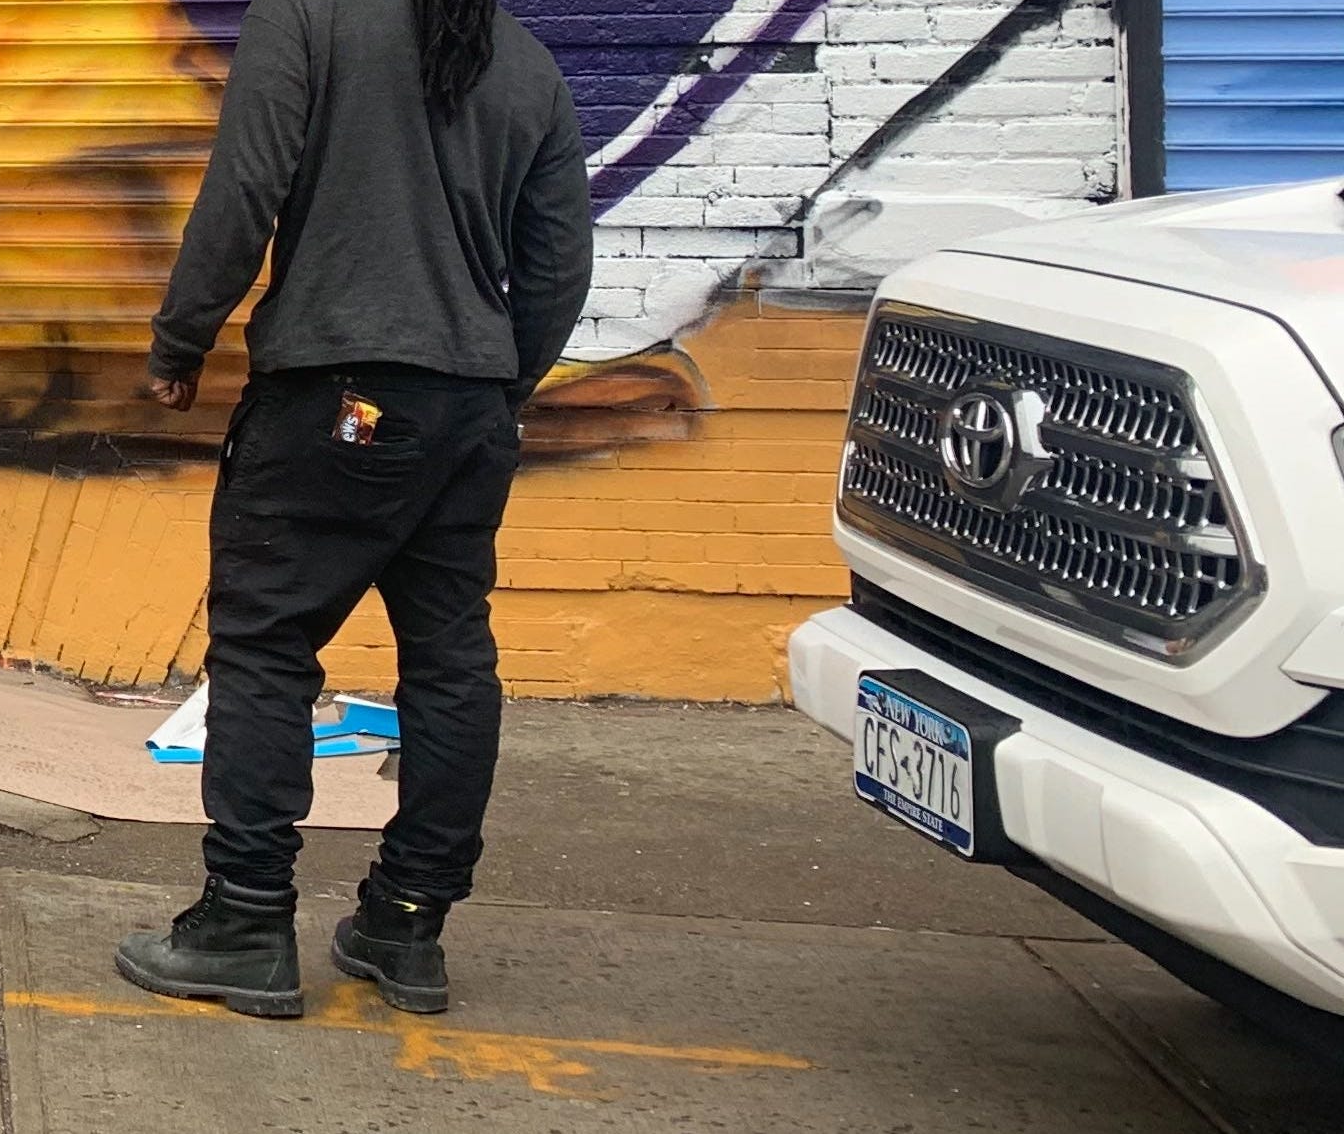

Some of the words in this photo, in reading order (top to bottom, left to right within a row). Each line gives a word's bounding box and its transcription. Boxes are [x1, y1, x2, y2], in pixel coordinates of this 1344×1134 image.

[885, 696, 911, 729] NEW
[911, 710, 946, 746] YORK
[883, 788, 897, 806] THE
[897, 796, 922, 821] EMPIRE
[922, 809, 943, 833] STATE
